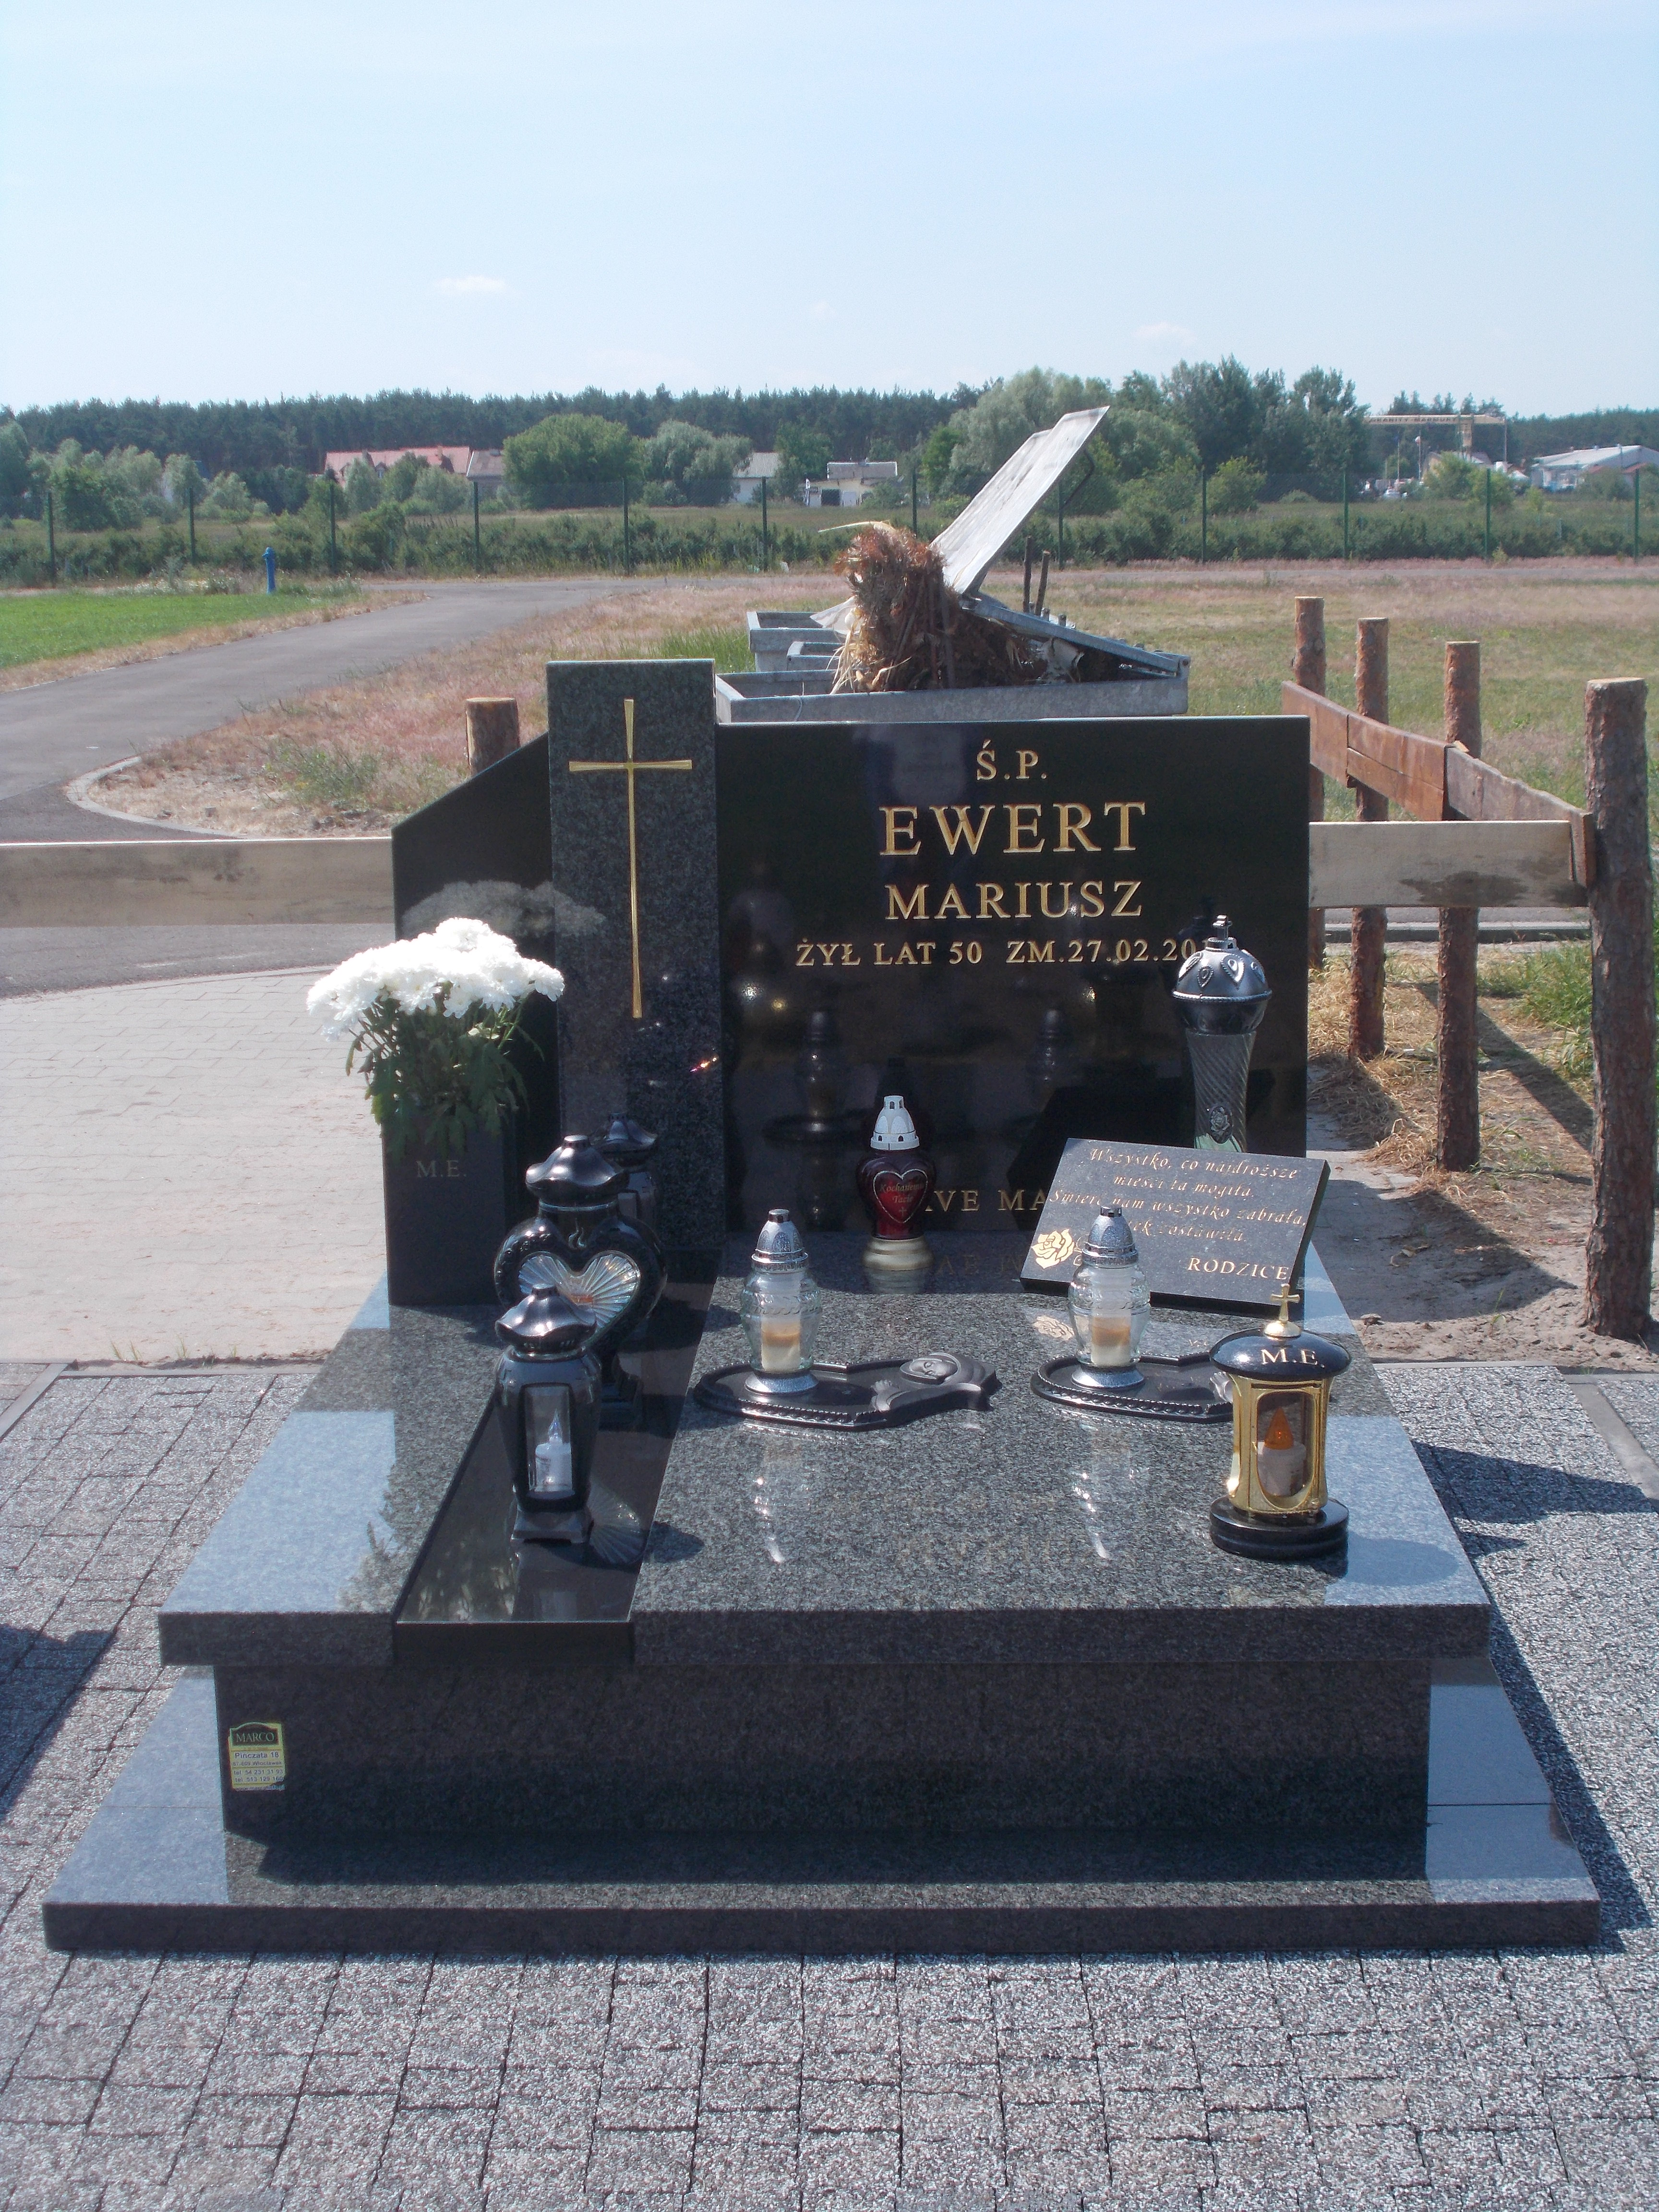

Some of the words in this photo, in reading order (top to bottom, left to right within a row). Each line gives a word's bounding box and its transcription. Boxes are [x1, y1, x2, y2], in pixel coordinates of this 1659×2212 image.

[976, 739, 1048, 780] Ś.P.
[878, 801, 1146, 856] EWERT
[884, 880, 1142, 920] MARIUSZ
[795, 938, 861, 967] ŻYŁ
[873, 941, 936, 965] LAT
[949, 940, 983, 964] 50
[1006, 938, 1207, 963] ZM.27.02.20
[416, 1160, 467, 1178] M.E.
[1181, 1160, 1199, 1170] co
[1205, 1159, 1298, 1179] najdroższe
[1170, 1178, 1188, 1191] ta
[925, 1189, 980, 1212] VE
[997, 1188, 1047, 1211] MA
[1112, 1198, 1145, 1209] nam
[1153, 1202, 1230, 1220] wszystko
[1187, 1257, 1290, 1281] RODZICE
[1260, 1347, 1325, 1369] M.E.
[236, 1731, 275, 1743] MARCO
